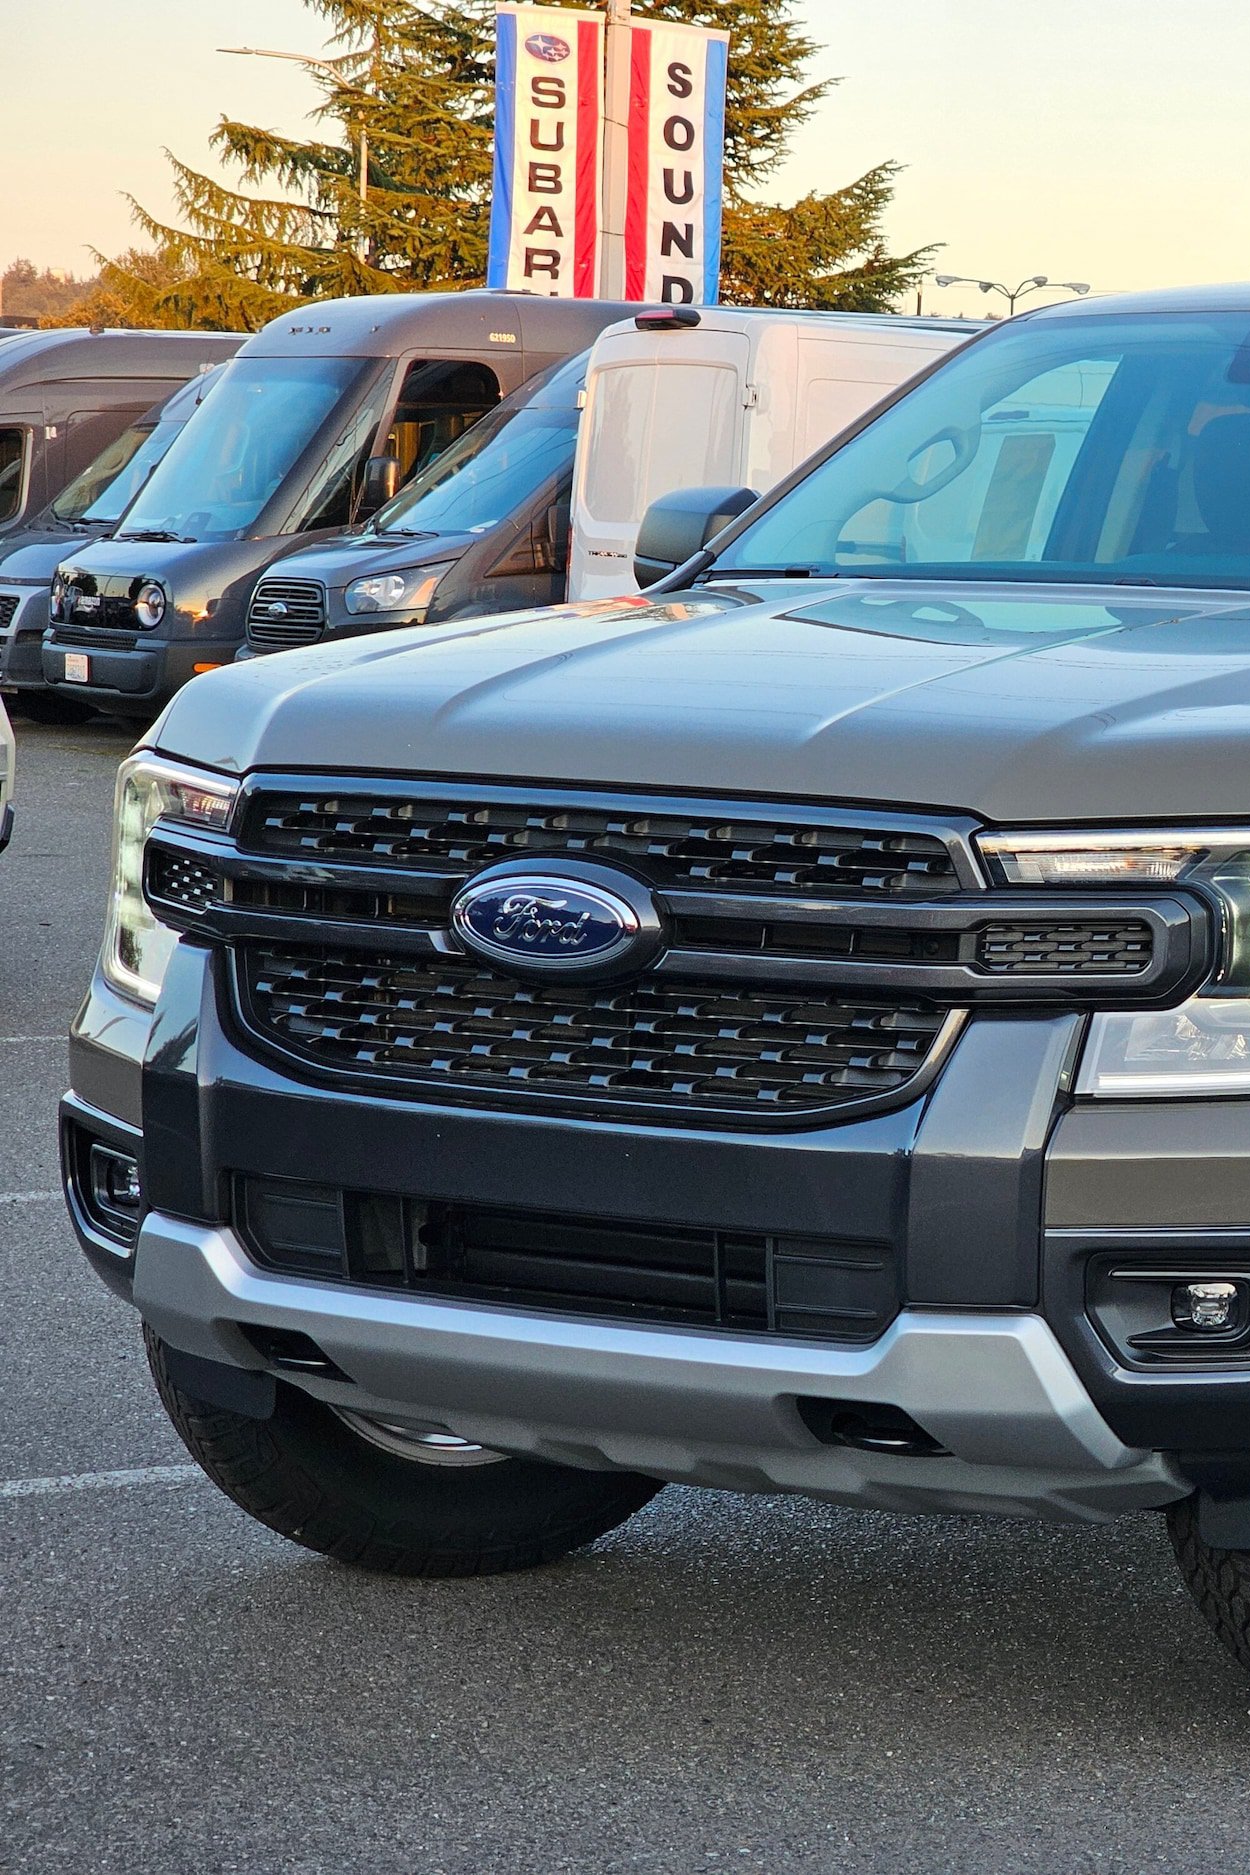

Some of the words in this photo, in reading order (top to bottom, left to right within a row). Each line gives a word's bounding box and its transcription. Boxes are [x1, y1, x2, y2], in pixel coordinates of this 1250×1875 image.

[523, 76, 566, 297] SUBAR
[660, 62, 695, 304] SOUND
[492, 894, 591, 946] Ford
